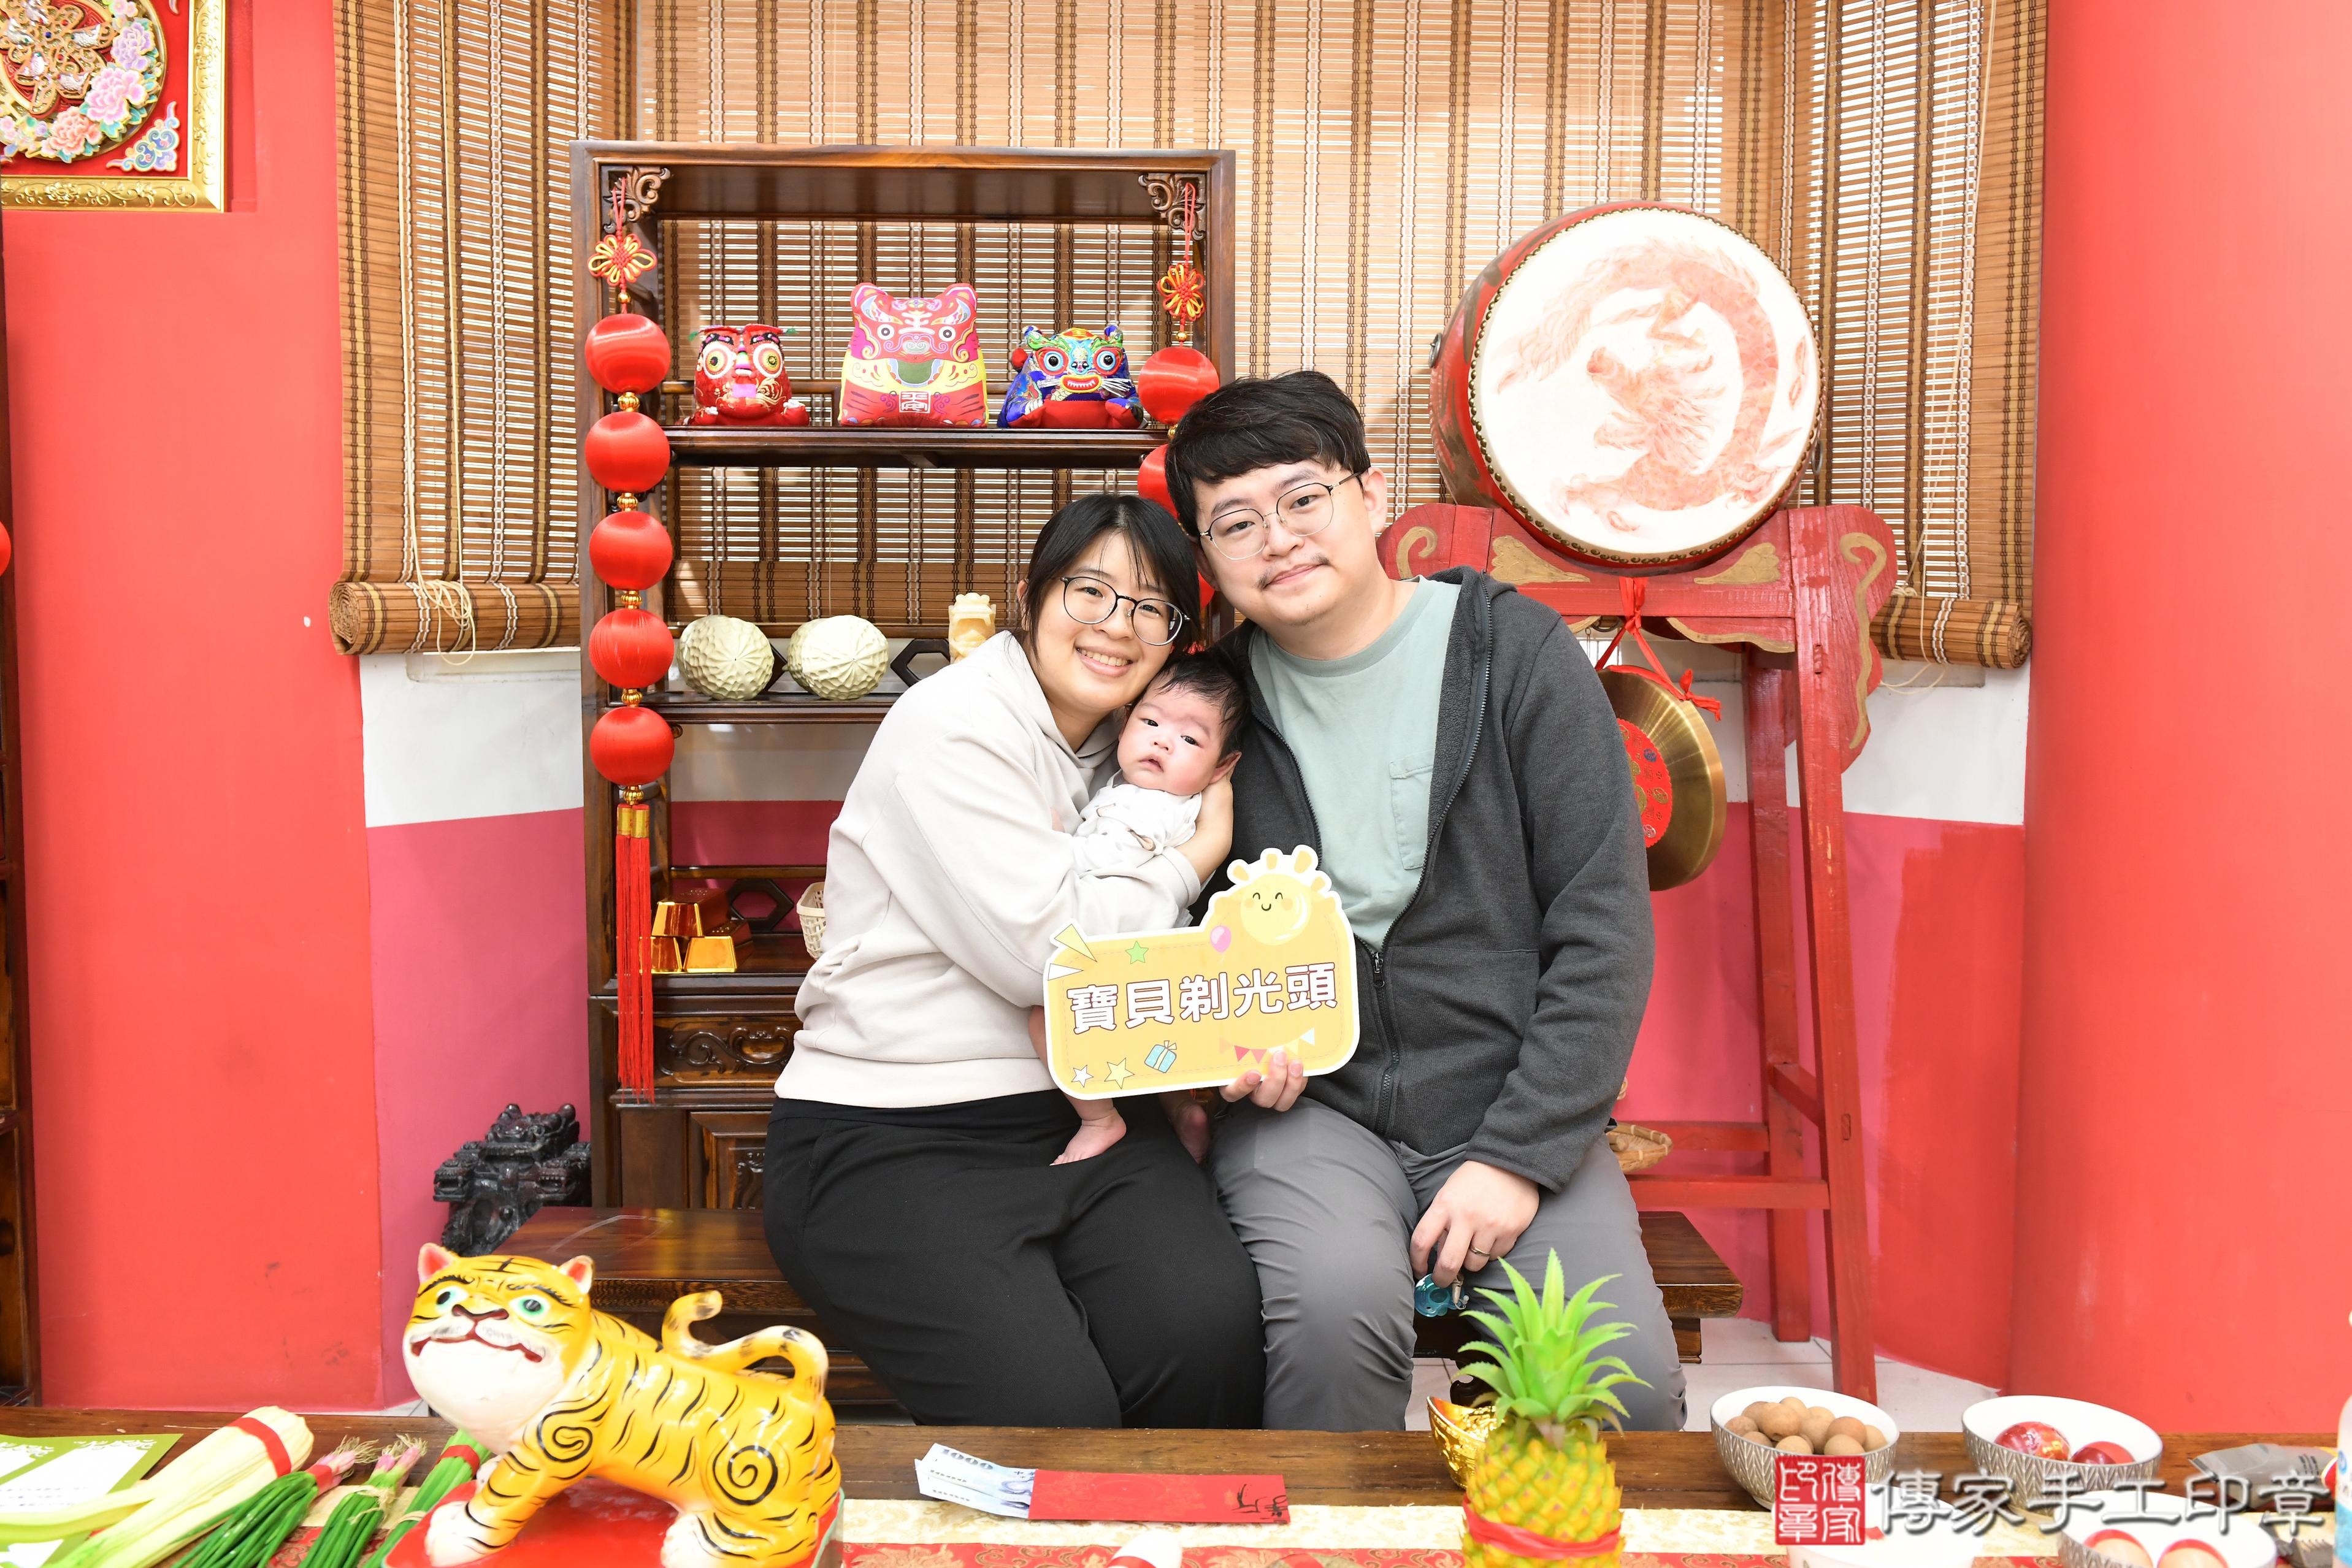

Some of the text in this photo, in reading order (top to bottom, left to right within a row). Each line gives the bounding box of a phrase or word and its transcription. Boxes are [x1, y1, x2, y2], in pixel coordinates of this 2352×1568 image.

[1065, 962, 1338, 1035] 寶貝剃光頭
[941, 1448, 994, 1470] 1000
